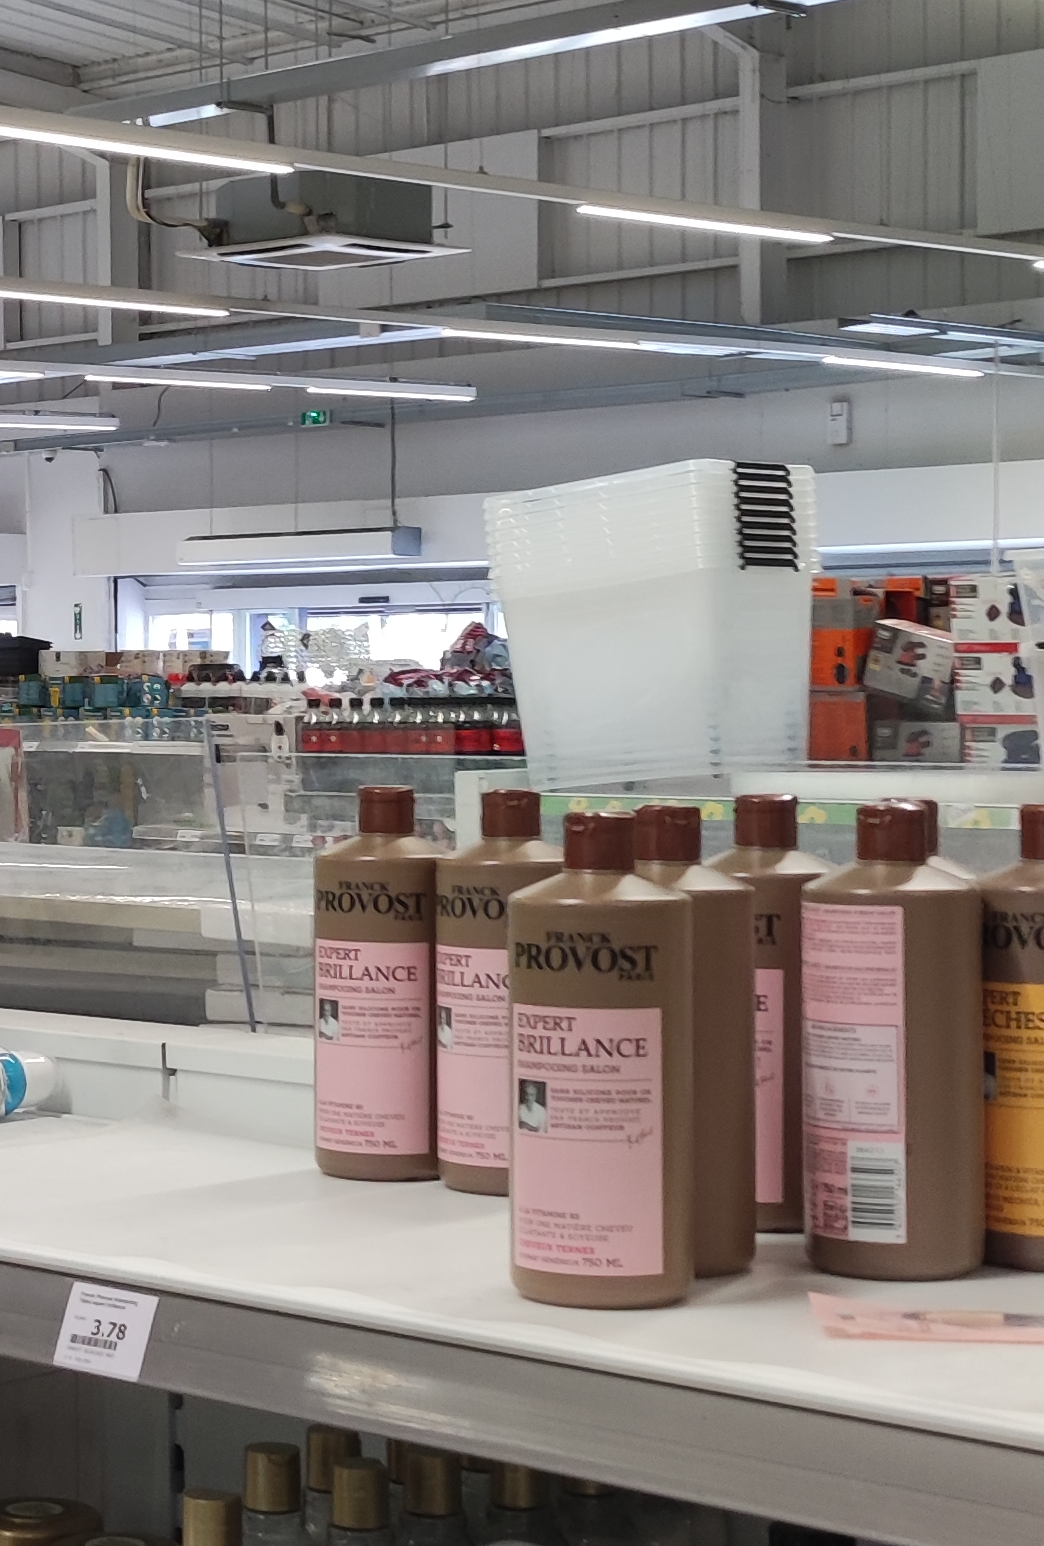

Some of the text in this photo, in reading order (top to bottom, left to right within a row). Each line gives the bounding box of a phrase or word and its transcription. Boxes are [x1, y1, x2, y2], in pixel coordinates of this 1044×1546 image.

[338, 880, 390, 893] FRANCK
[316, 889, 427, 915] PROVOST
[546, 930, 611, 945] FRANCK
[319, 945, 362, 962] EXPERT
[514, 941, 659, 974] PROVOST
[318, 962, 418, 983] BRILLANCE
[517, 1011, 577, 1033] EXPERT
[517, 1032, 648, 1059] BRILLANCE
[582, 1064, 621, 1075] SALON
[582, 1257, 603, 1268] 750
[90, 1318, 128, 1341] 3.78
